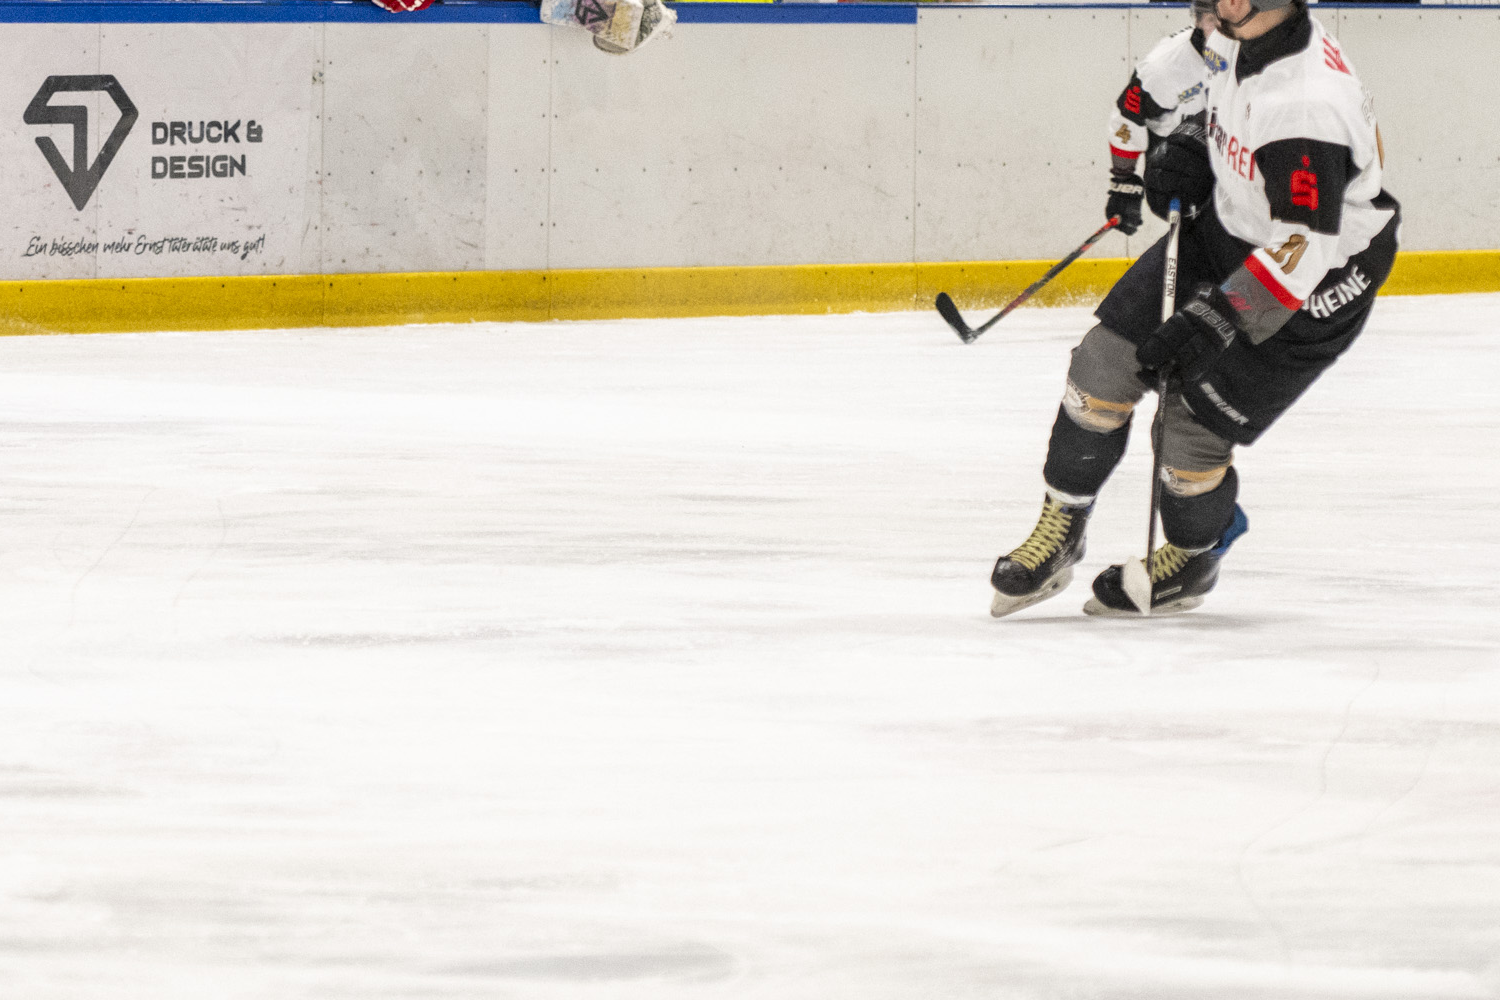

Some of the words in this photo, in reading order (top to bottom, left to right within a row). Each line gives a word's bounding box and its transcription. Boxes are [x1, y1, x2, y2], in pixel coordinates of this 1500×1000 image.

[151, 119, 241, 146] DRUCK
[246, 119, 264, 143] &
[151, 154, 247, 180] DESIGN
[22, 236, 48, 257] Ein
[50, 236, 100, 257] bisschen
[103, 237, 134, 253] mehr
[134, 234, 167, 256] Ernst
[219, 239, 240, 254] uns
[240, 233, 267, 261] gut!
[1301, 264, 1372, 319] HEINE
